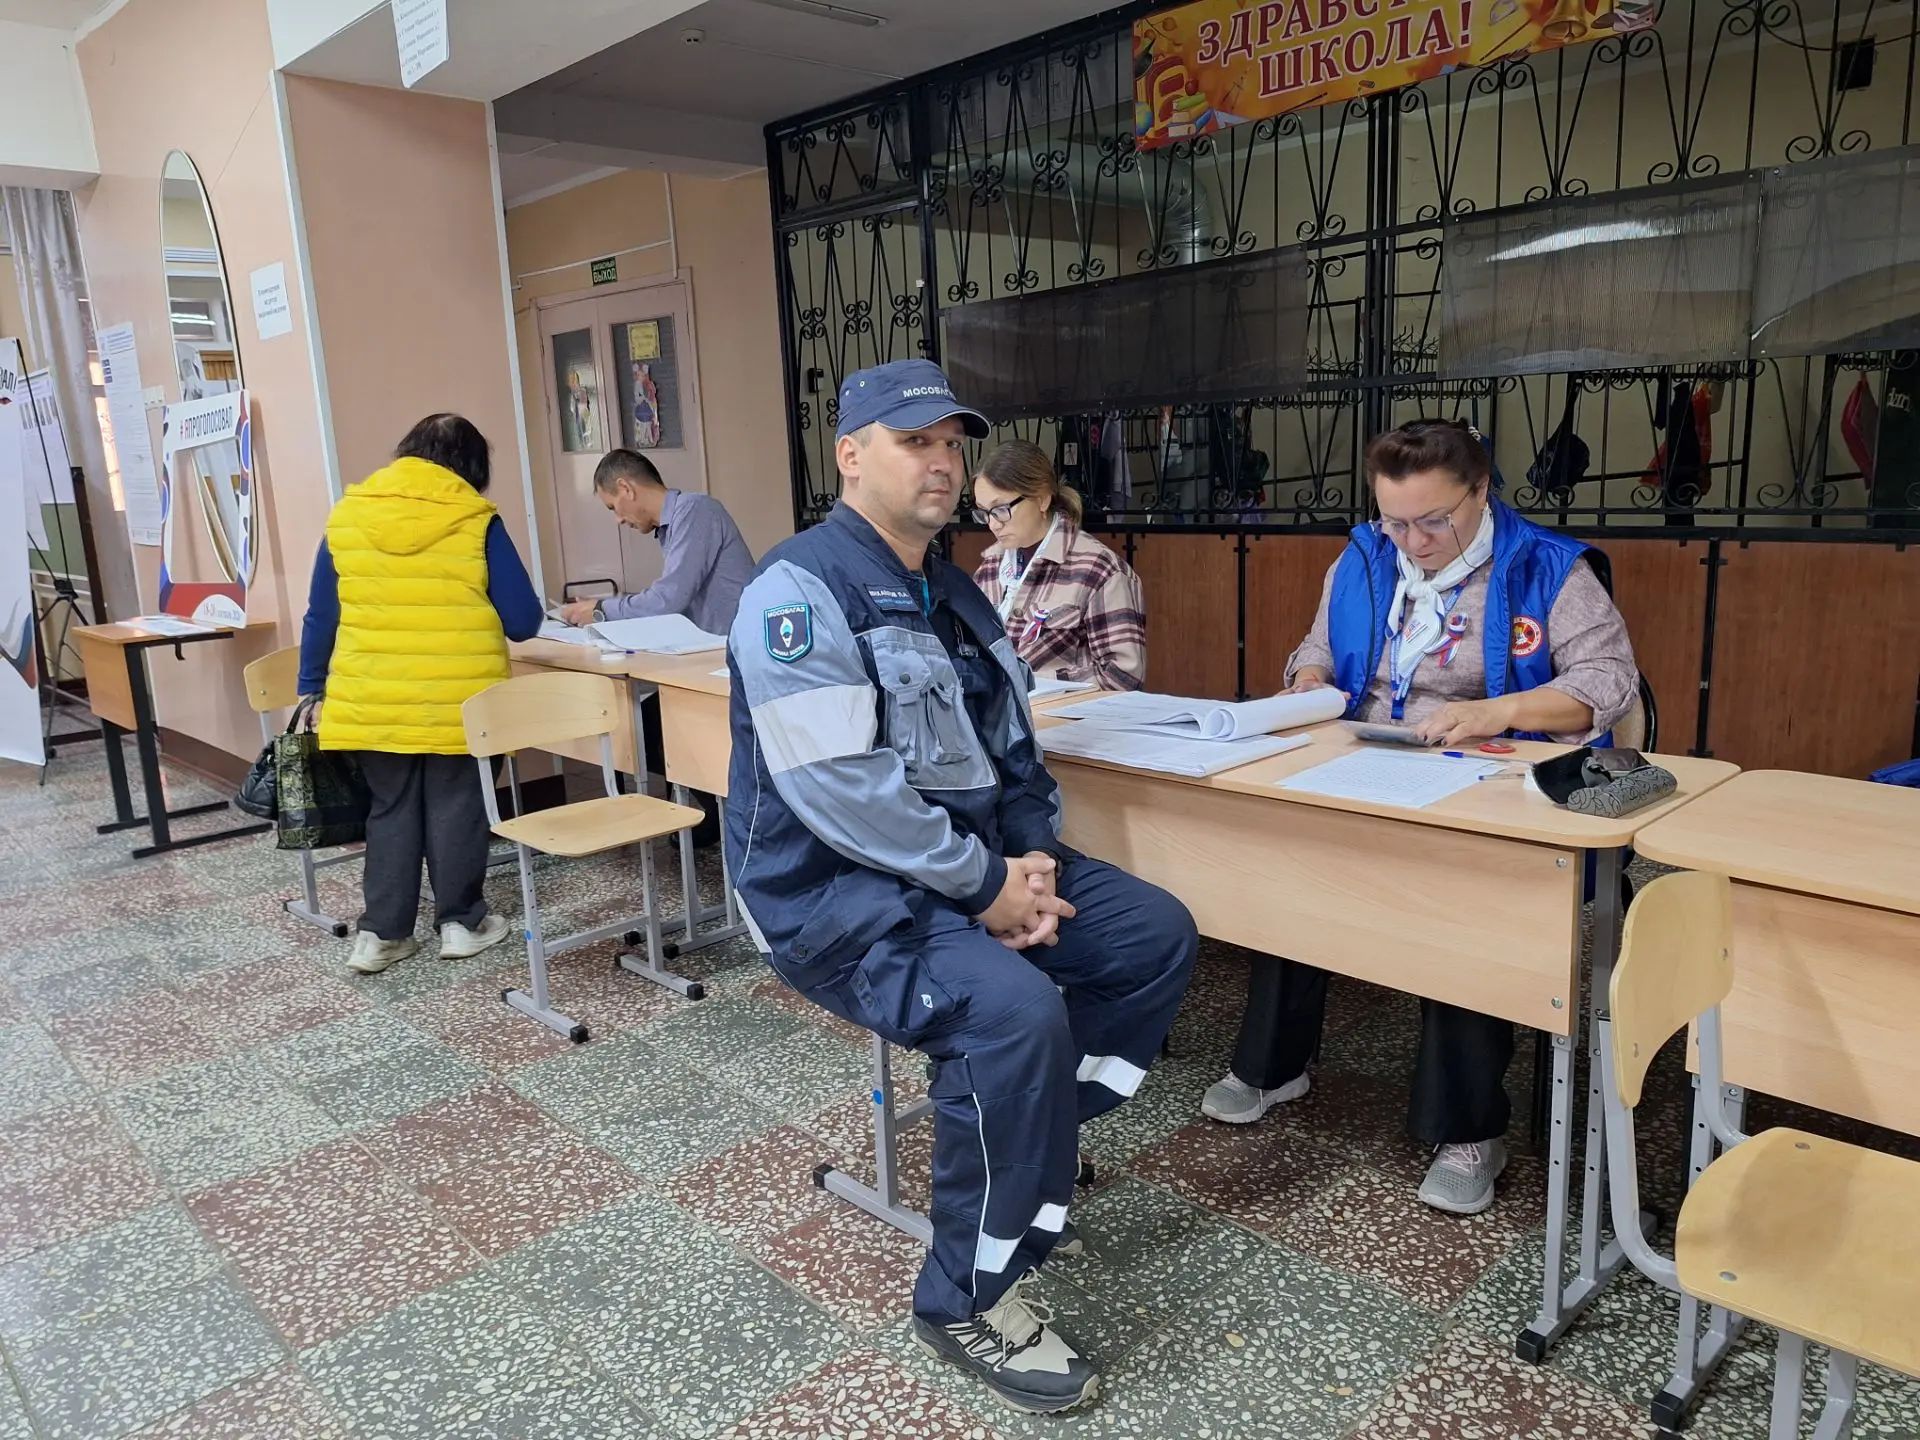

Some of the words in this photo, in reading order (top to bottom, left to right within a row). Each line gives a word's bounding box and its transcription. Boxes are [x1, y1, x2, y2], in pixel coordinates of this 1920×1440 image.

[1198, 0, 1405, 65] ЗДРАВ
[1258, 0, 1472, 98] ШКОЛА!
[593, 267, 617, 283] ВЫХОД
[180, 405, 233, 440] #ЯПРОГОЛОСОВАЛ
